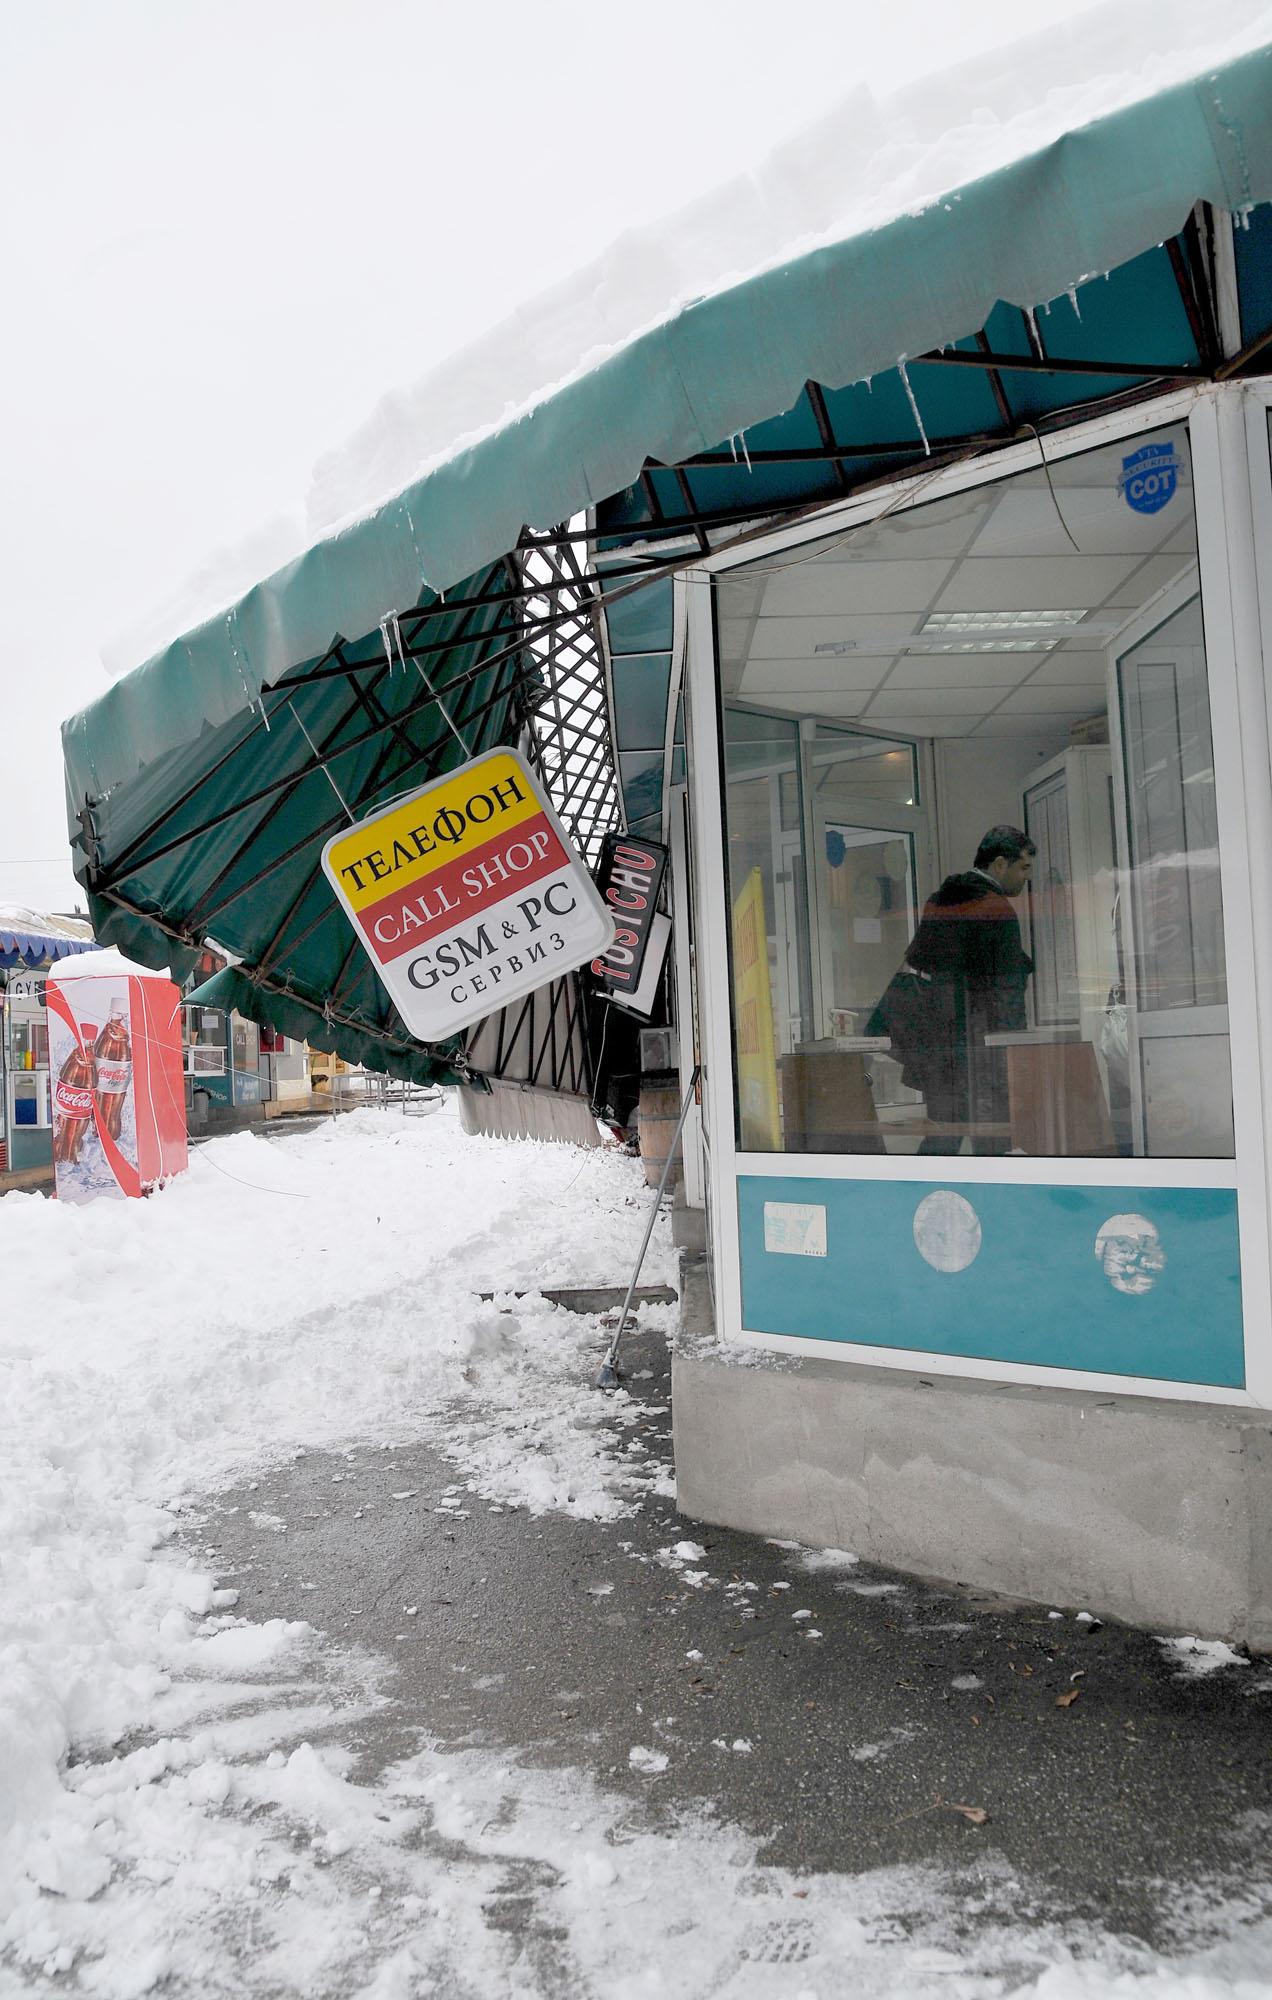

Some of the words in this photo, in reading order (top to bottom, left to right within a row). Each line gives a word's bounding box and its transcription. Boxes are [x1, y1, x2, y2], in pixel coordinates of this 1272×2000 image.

[342, 776, 525, 892] ТЕЛЕФОН
[373, 886, 461, 944] CALL
[466, 831, 550, 898] SHOP
[407, 923, 498, 990] GSM
[501, 920, 519, 939] &
[517, 882, 577, 932] PC
[450, 933, 565, 1004] СЕРВИЗ
[56, 1087, 94, 1108] Coca-Cola
